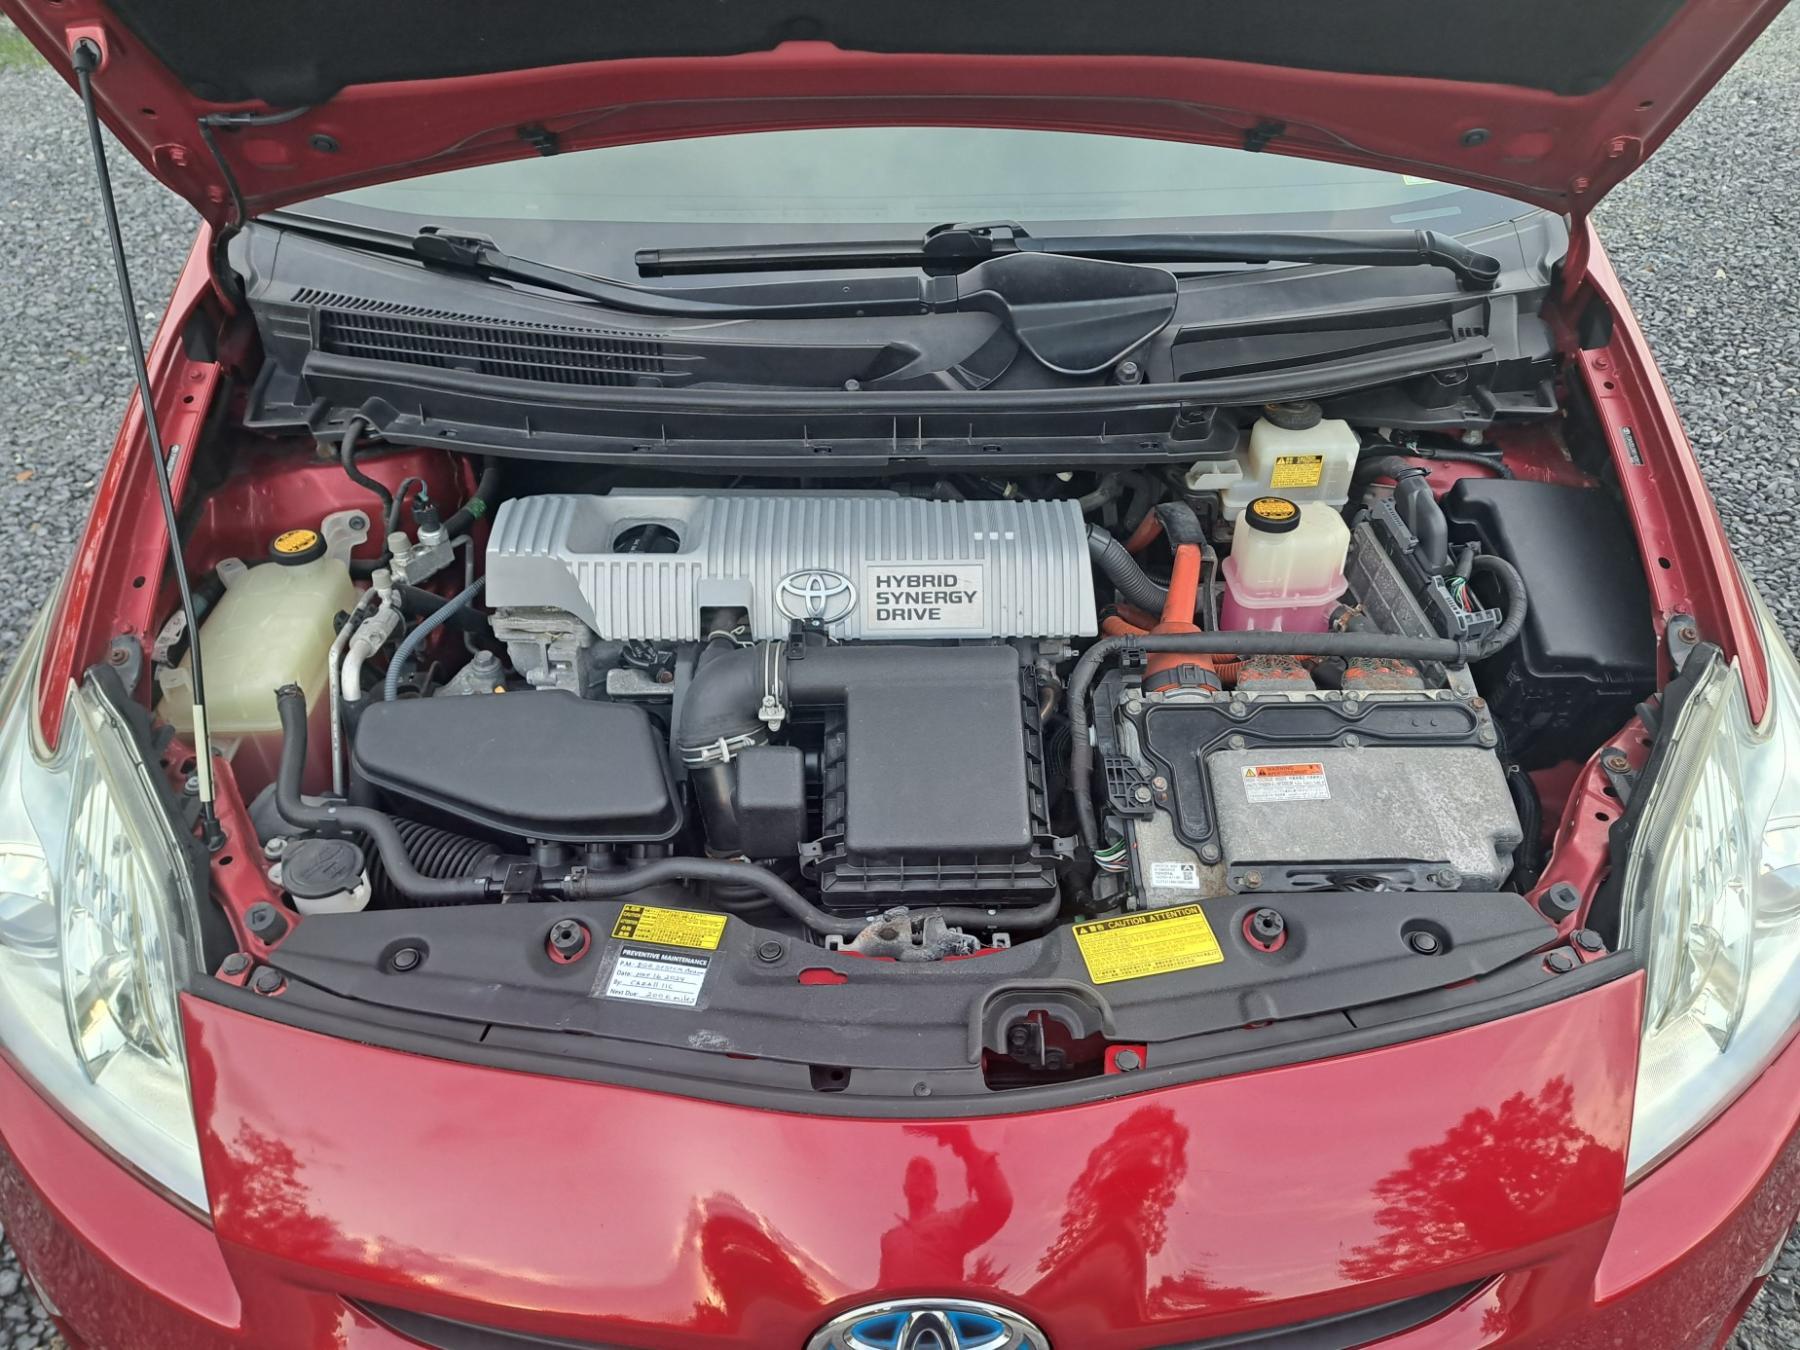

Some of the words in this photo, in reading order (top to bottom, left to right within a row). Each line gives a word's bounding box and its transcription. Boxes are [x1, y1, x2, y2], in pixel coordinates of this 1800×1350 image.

[876, 574, 958, 588] HYBRID
[876, 590, 978, 605] SYNERGY
[876, 608, 942, 621] DRIVE
[1108, 916, 1147, 929] CAUTION
[1149, 907, 1198, 922] ATTENTION
[622, 949, 660, 960] PREVENTIVE
[661, 952, 708, 966] MAINTENANCE
